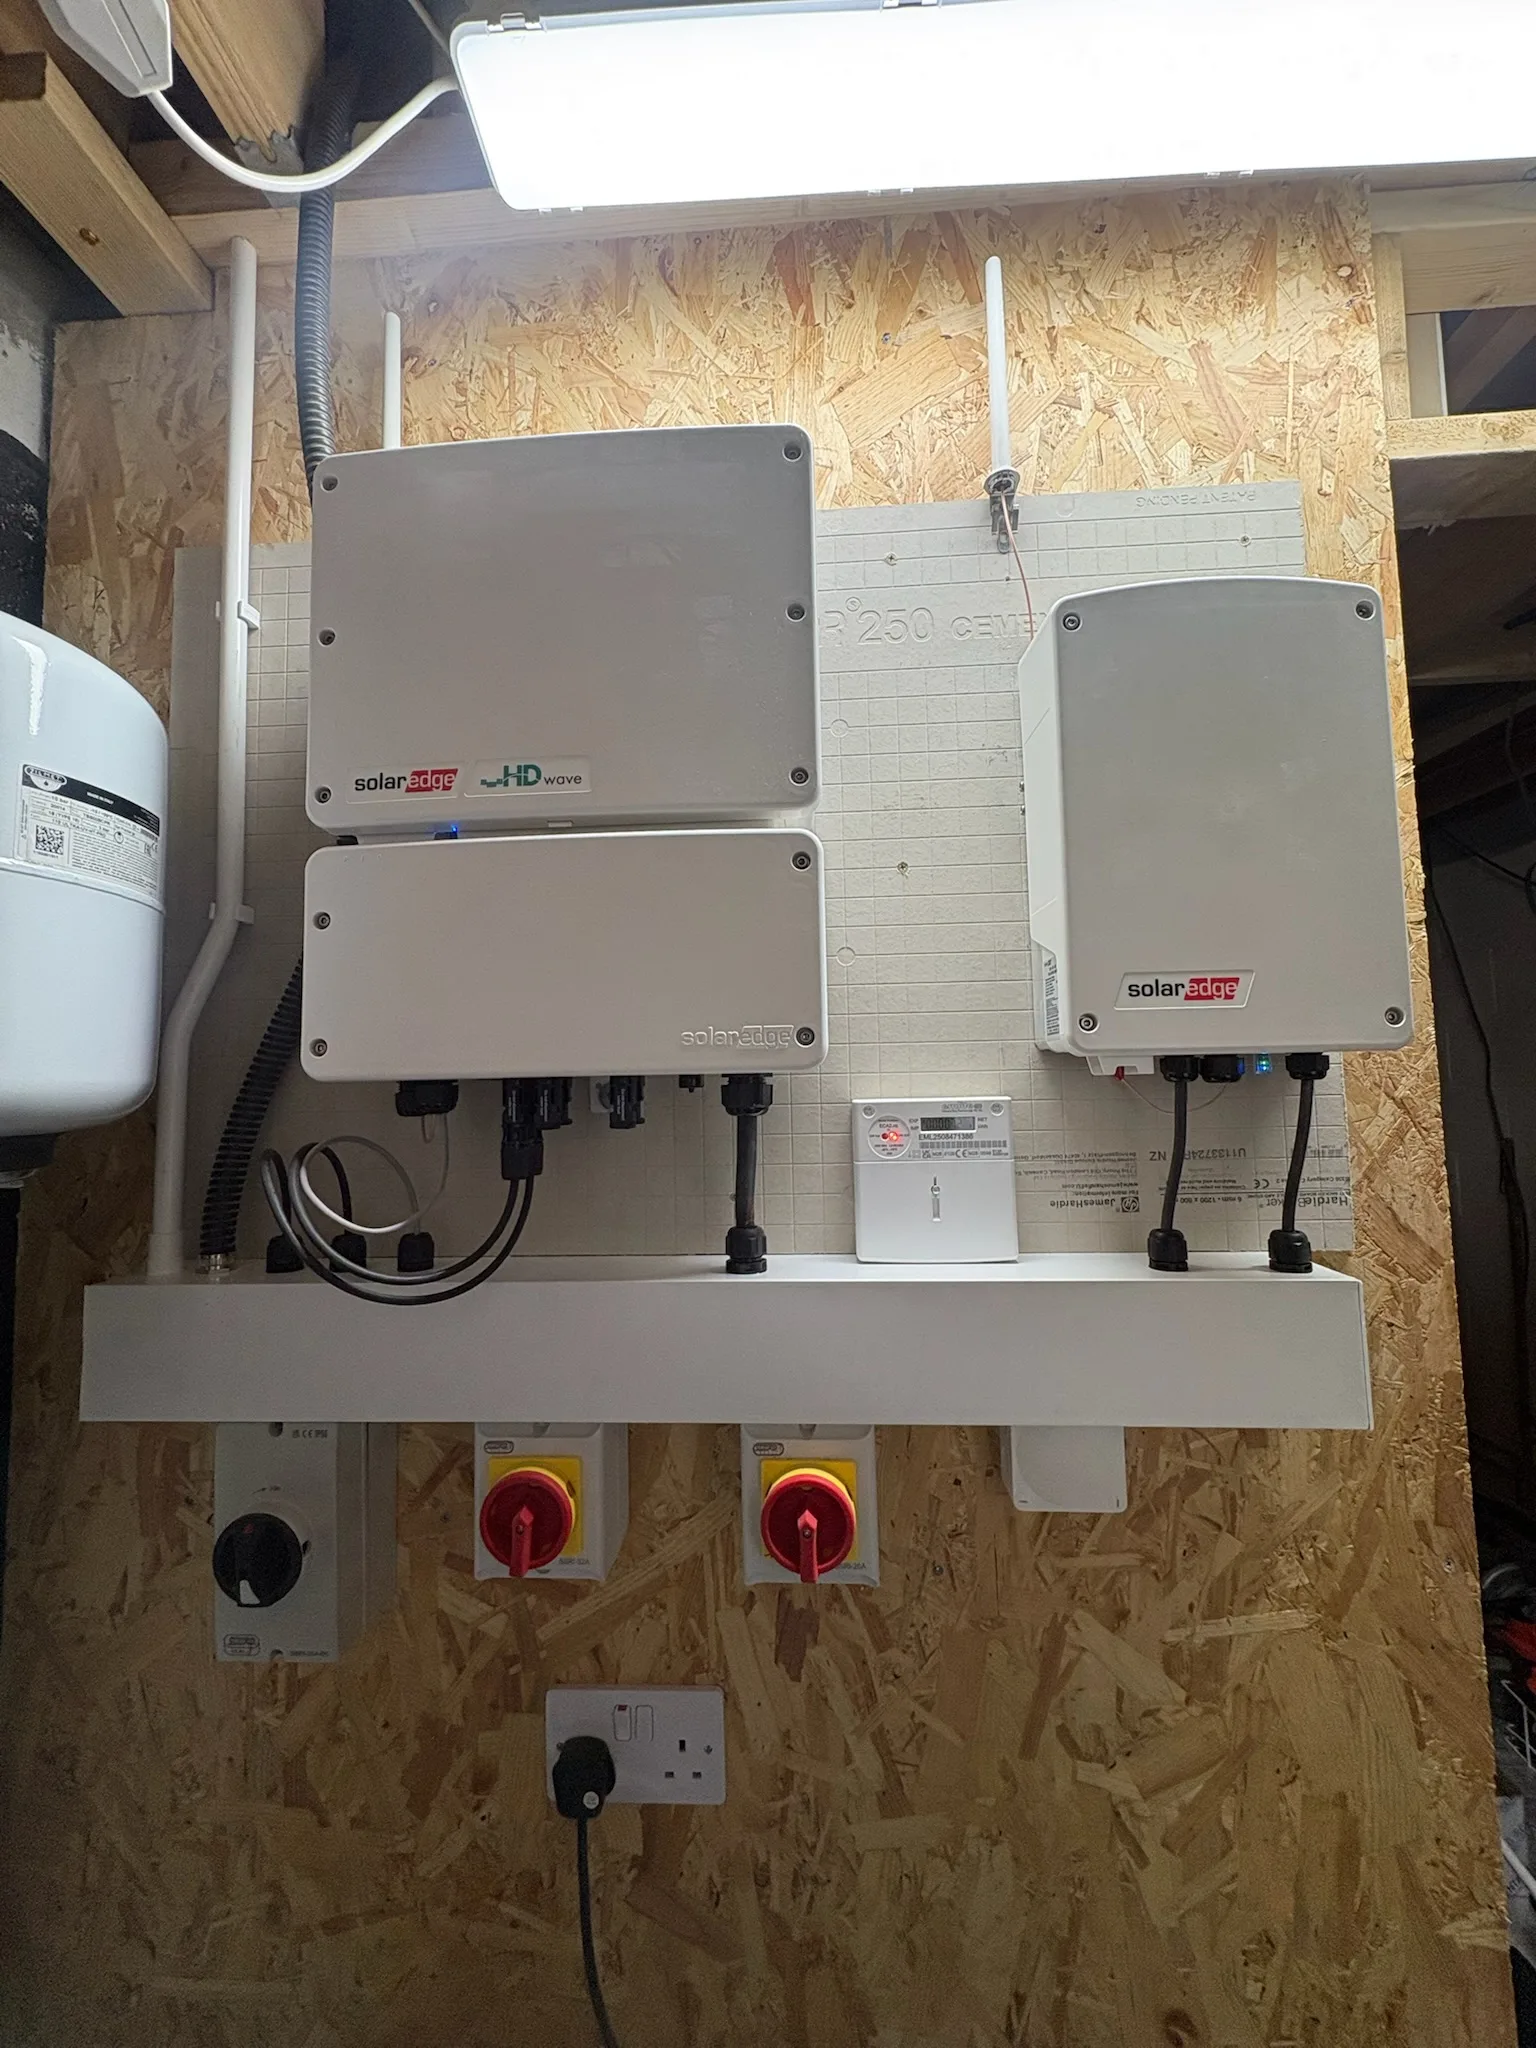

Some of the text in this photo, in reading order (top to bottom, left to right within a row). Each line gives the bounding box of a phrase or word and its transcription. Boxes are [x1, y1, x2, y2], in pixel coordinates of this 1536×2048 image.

[857, 606, 934, 646] 250
[354, 768, 457, 793] solaredge
[503, 764, 582, 787] HD wave
[1128, 978, 1238, 1001] solaredge
[680, 1025, 792, 1049] solaredge
[1149, 1151, 1166, 1161] NZ
[1050, 1198, 1116, 1208] JamesHardie
